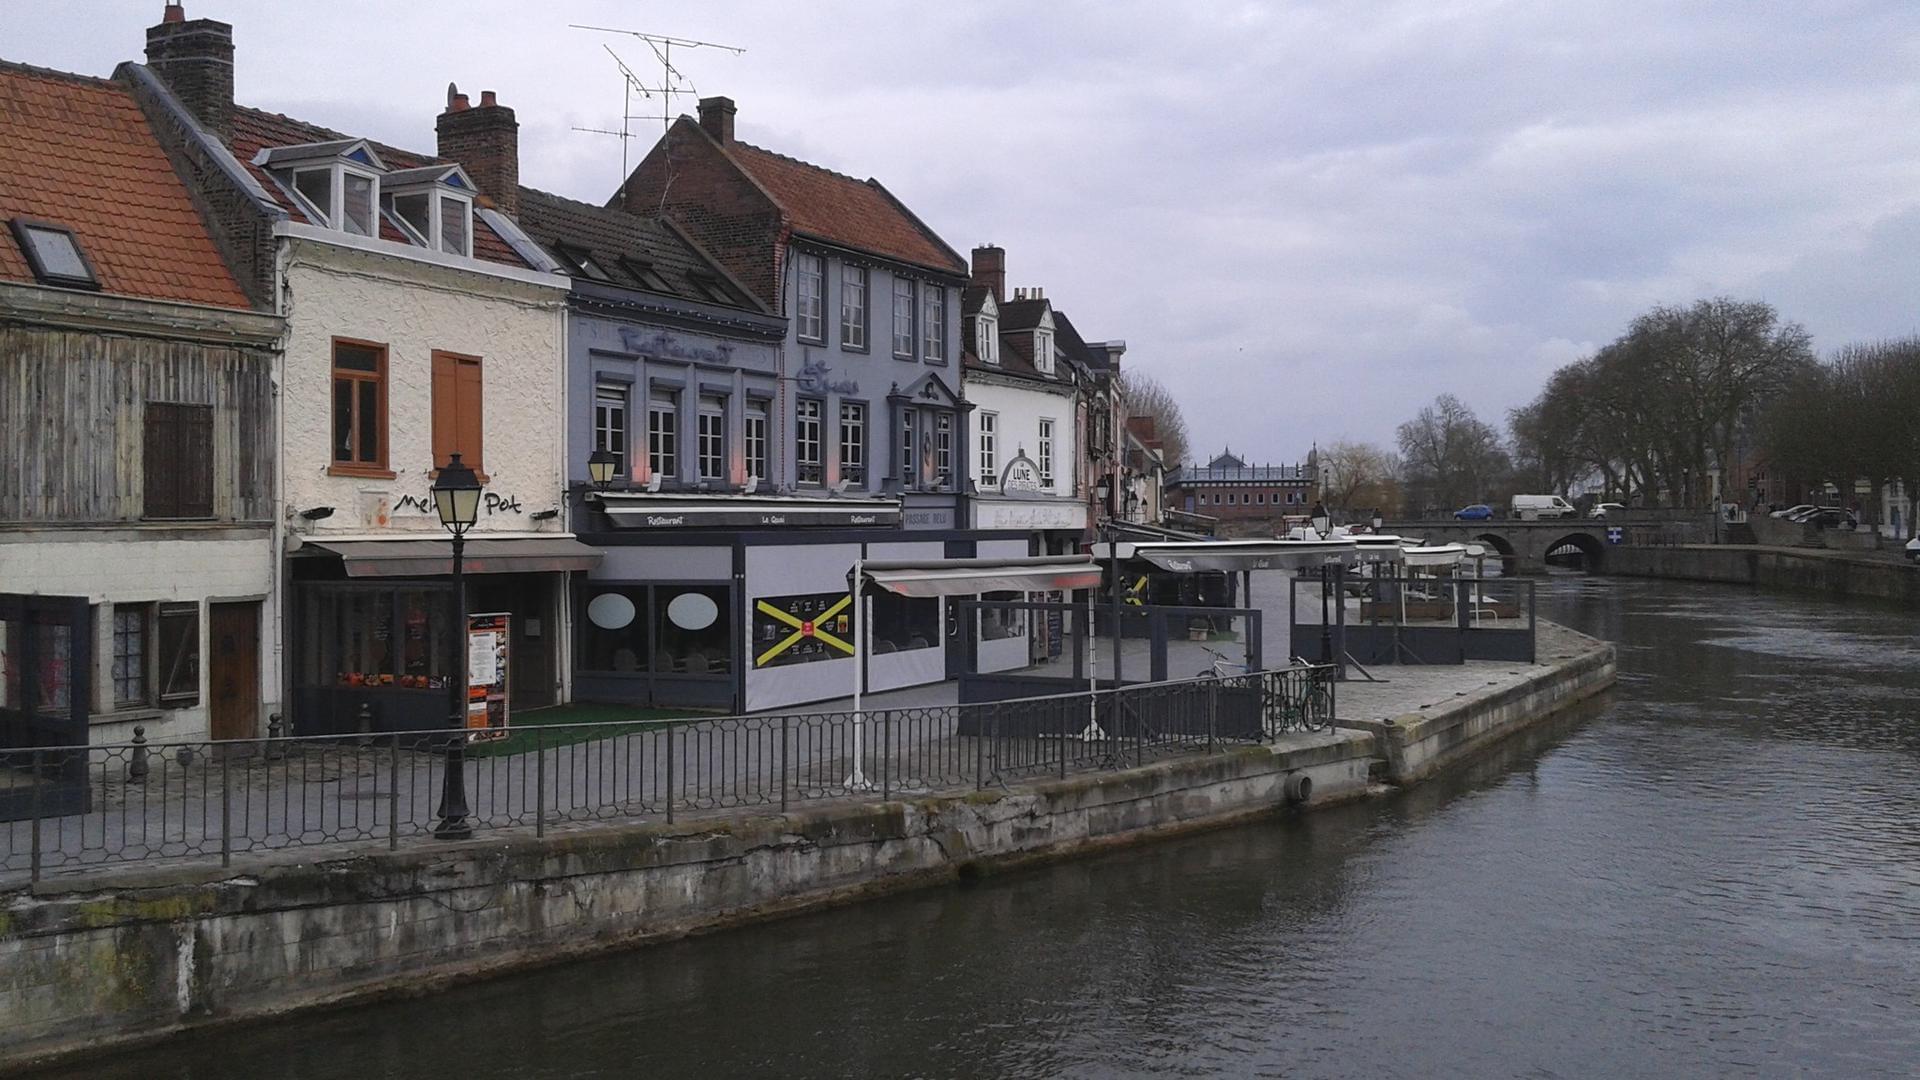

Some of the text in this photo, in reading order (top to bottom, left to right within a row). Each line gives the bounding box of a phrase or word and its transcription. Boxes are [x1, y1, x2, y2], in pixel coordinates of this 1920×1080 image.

[1012, 468, 1030, 481] LUNE
[484, 493, 522, 515] Pot
[647, 516, 684, 526] Restaurant
[761, 515, 785, 524] Le Quai
[850, 515, 876, 524] Restaurant
